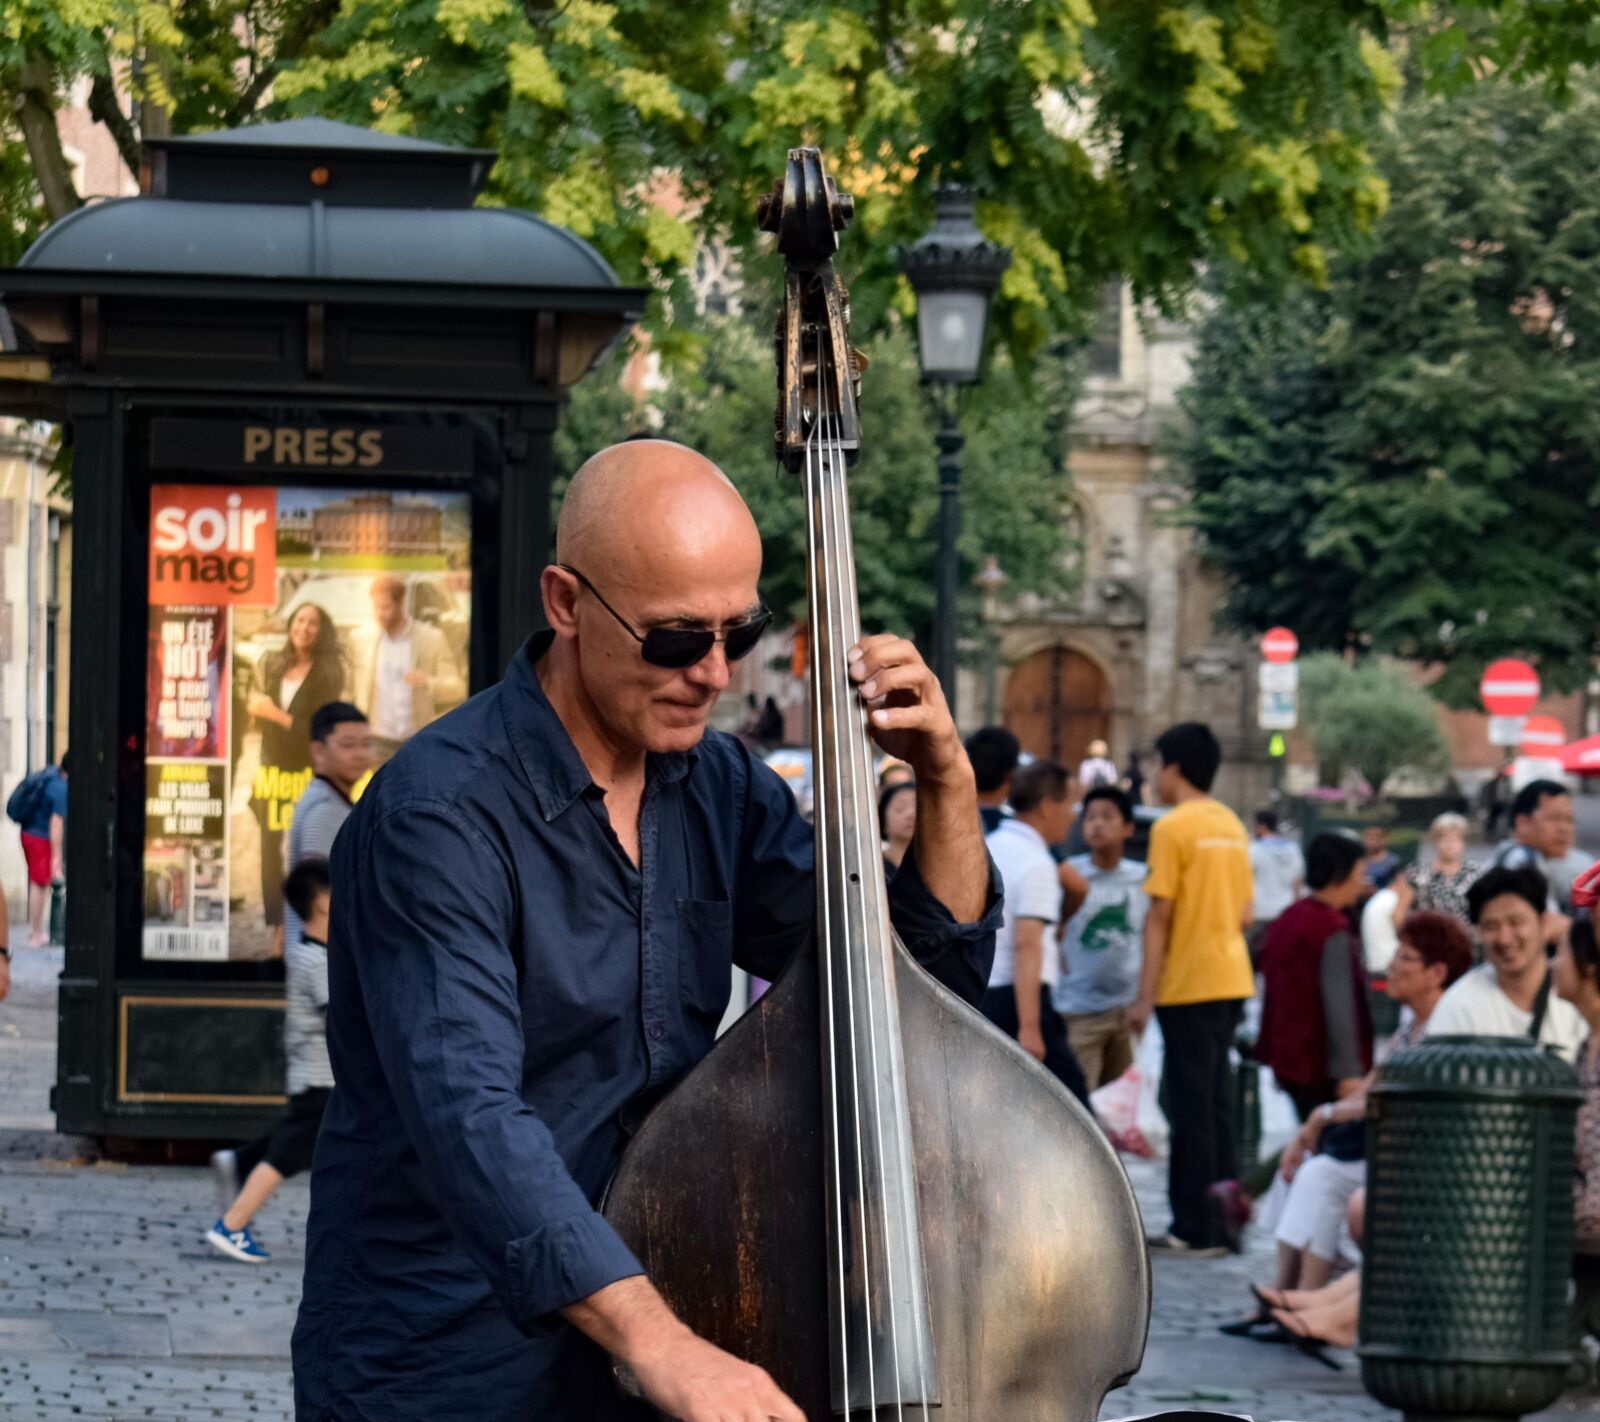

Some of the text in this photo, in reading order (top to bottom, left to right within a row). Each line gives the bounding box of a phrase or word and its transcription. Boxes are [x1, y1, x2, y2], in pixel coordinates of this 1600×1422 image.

[244, 427, 384, 466] PRESS
[154, 493, 267, 552] soir
[155, 553, 255, 594] mag
[163, 643, 212, 678] HOT
